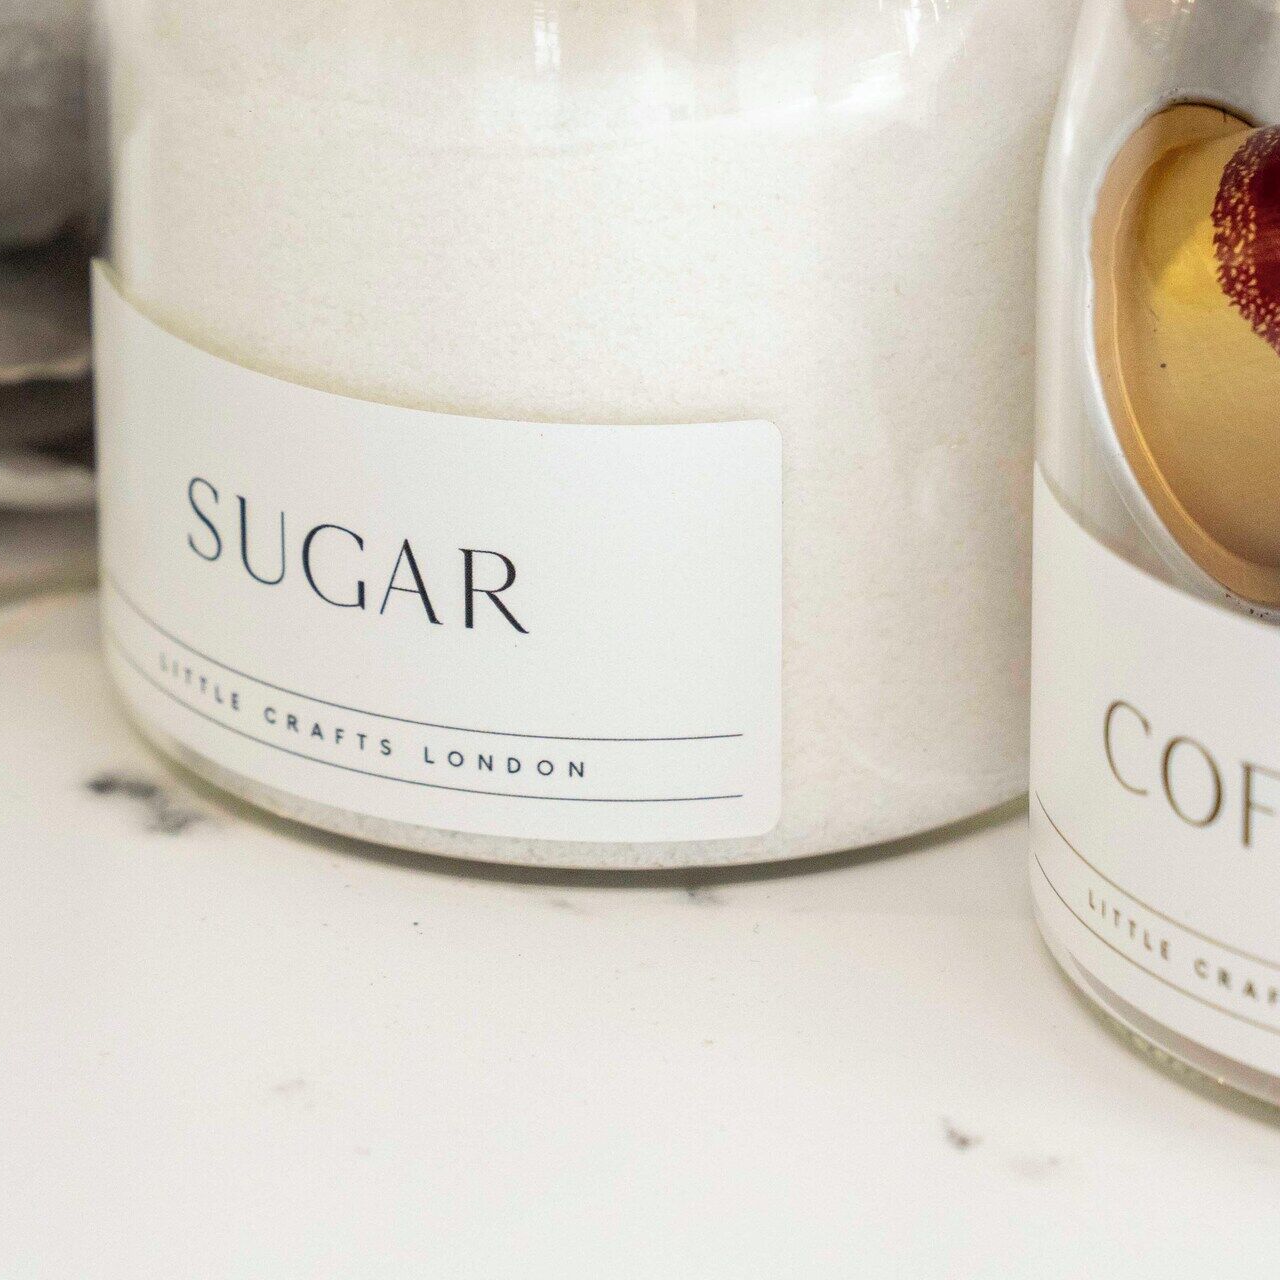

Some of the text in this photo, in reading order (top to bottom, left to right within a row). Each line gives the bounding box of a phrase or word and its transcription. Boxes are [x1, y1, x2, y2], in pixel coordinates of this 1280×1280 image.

[187, 476, 530, 635] SUGAR
[158, 652, 585, 779] LITTLE CRAFTS LONDON
[1087, 889, 1172, 961] LITTLE
